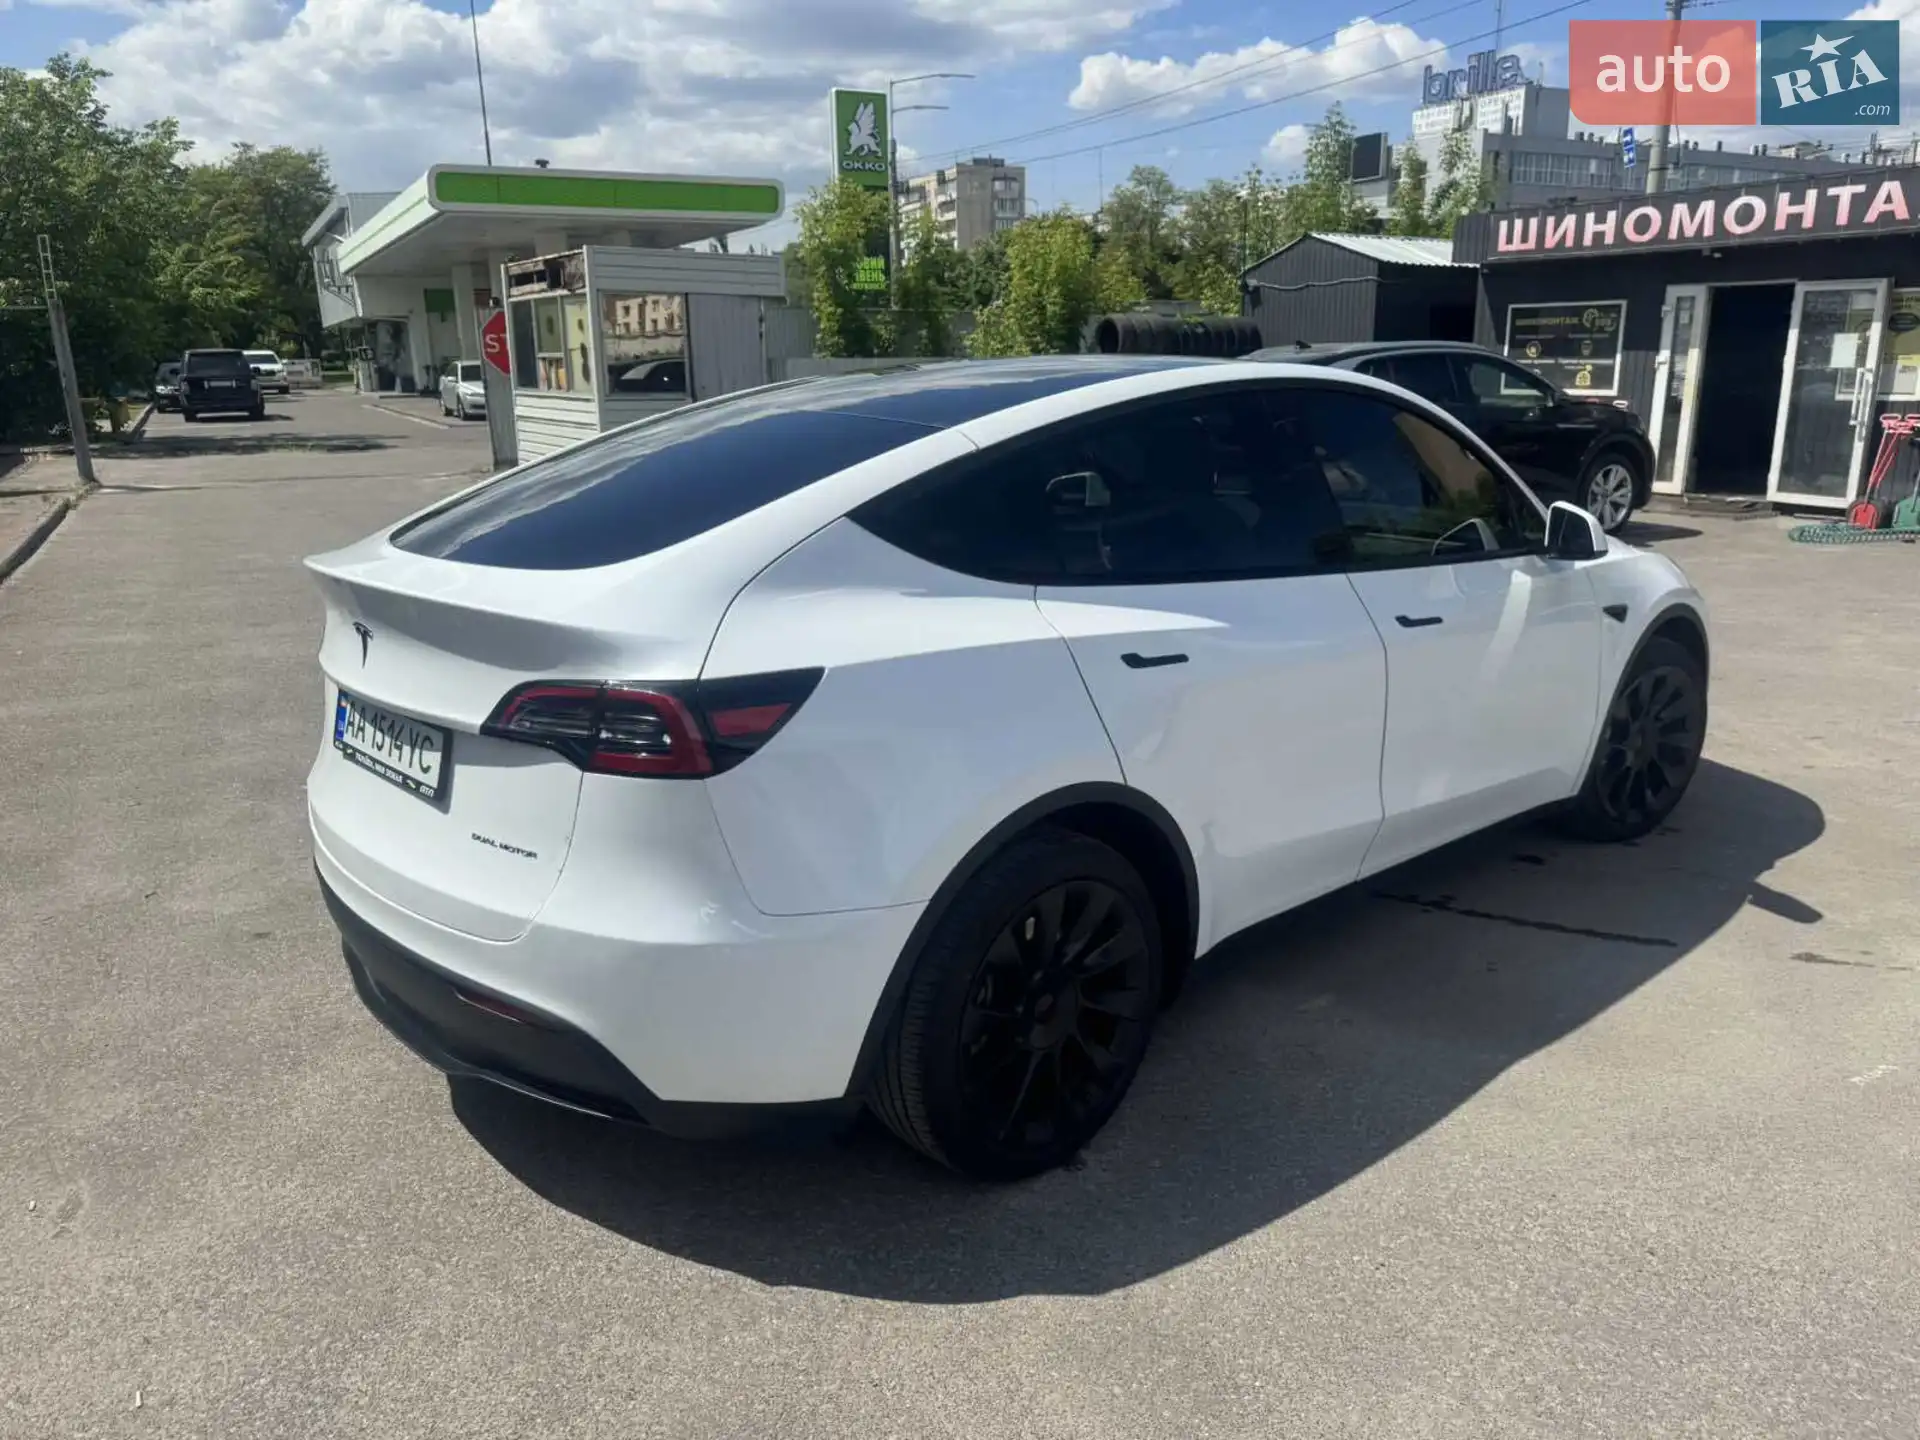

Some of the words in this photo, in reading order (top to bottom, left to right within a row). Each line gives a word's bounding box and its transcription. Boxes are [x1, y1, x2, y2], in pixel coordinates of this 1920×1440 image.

[1423, 49, 1520, 105] brille
[1496, 180, 1920, 252] ШИНОМОНТА
[345, 700, 366, 743] AA
[372, 712, 405, 763] 1514
[409, 727, 435, 774] YC
[471, 832, 498, 848] DUAL
[499, 842, 538, 860] MOTOR
